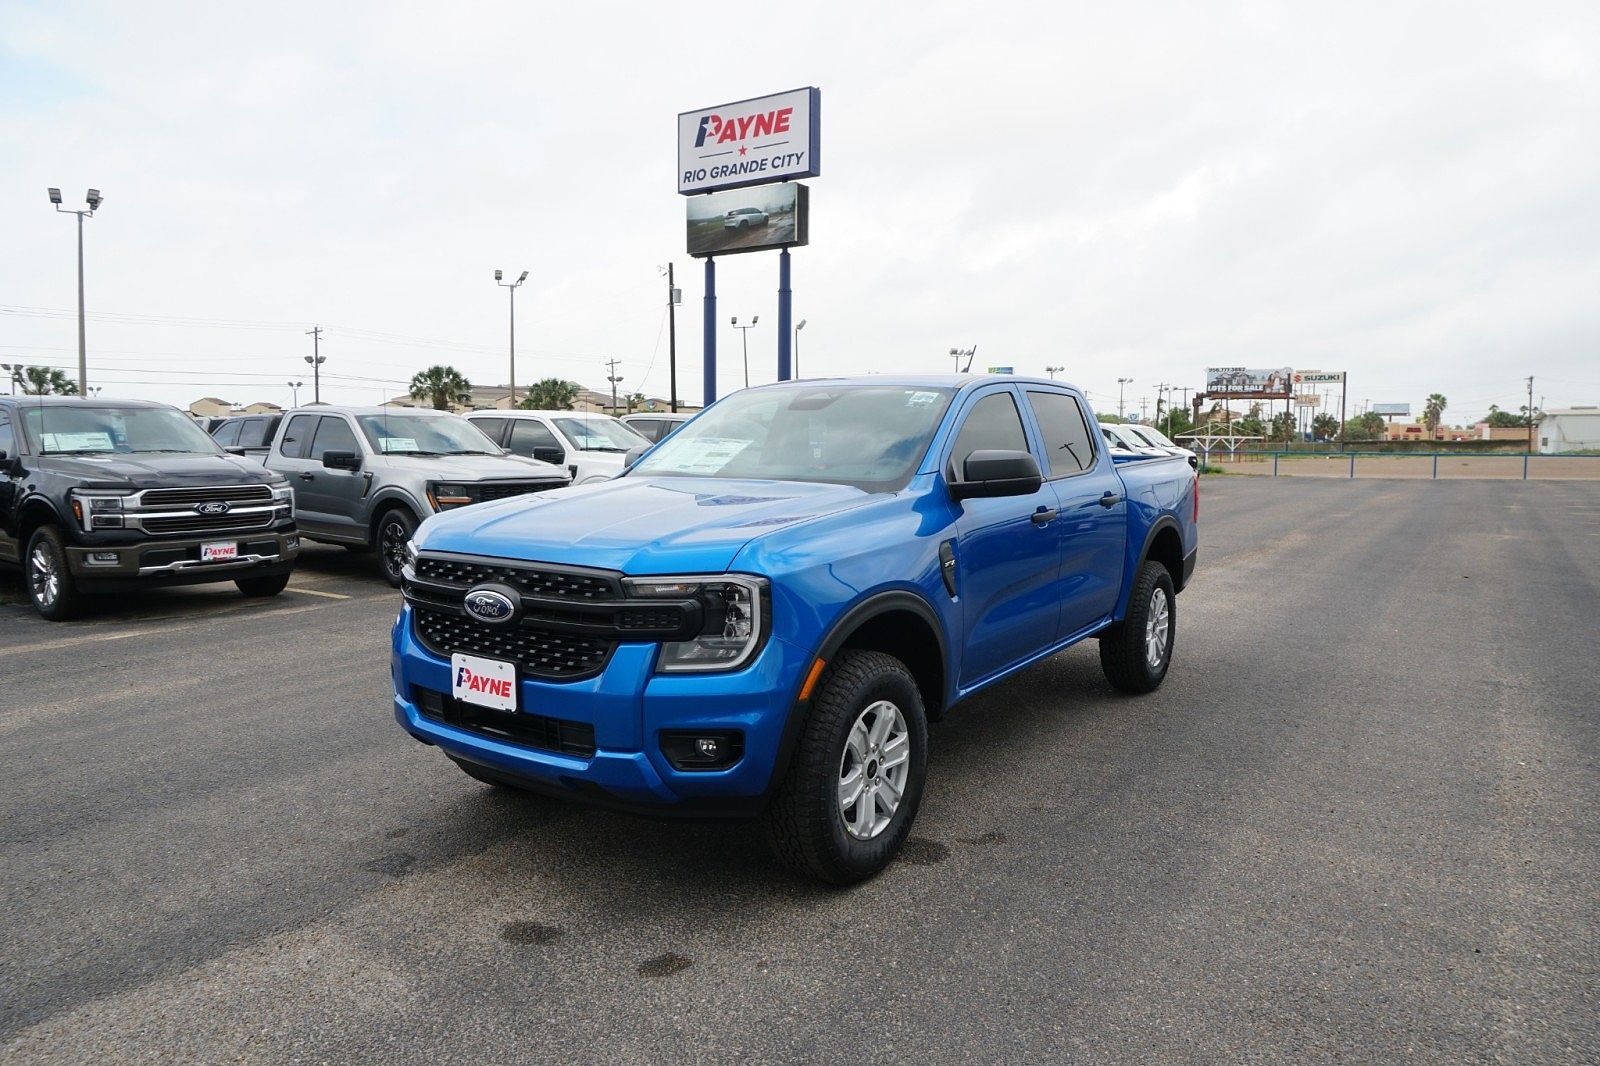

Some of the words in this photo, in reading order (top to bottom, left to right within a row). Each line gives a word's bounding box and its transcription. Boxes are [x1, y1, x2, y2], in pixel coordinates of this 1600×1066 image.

[694, 107, 793, 148] PAYNE
[683, 168, 707, 184] RIO
[710, 158, 768, 179] GRANDE
[771, 151, 805, 169] CITY
[203, 547, 235, 557] PAYNE
[456, 667, 512, 698] PAYNE
